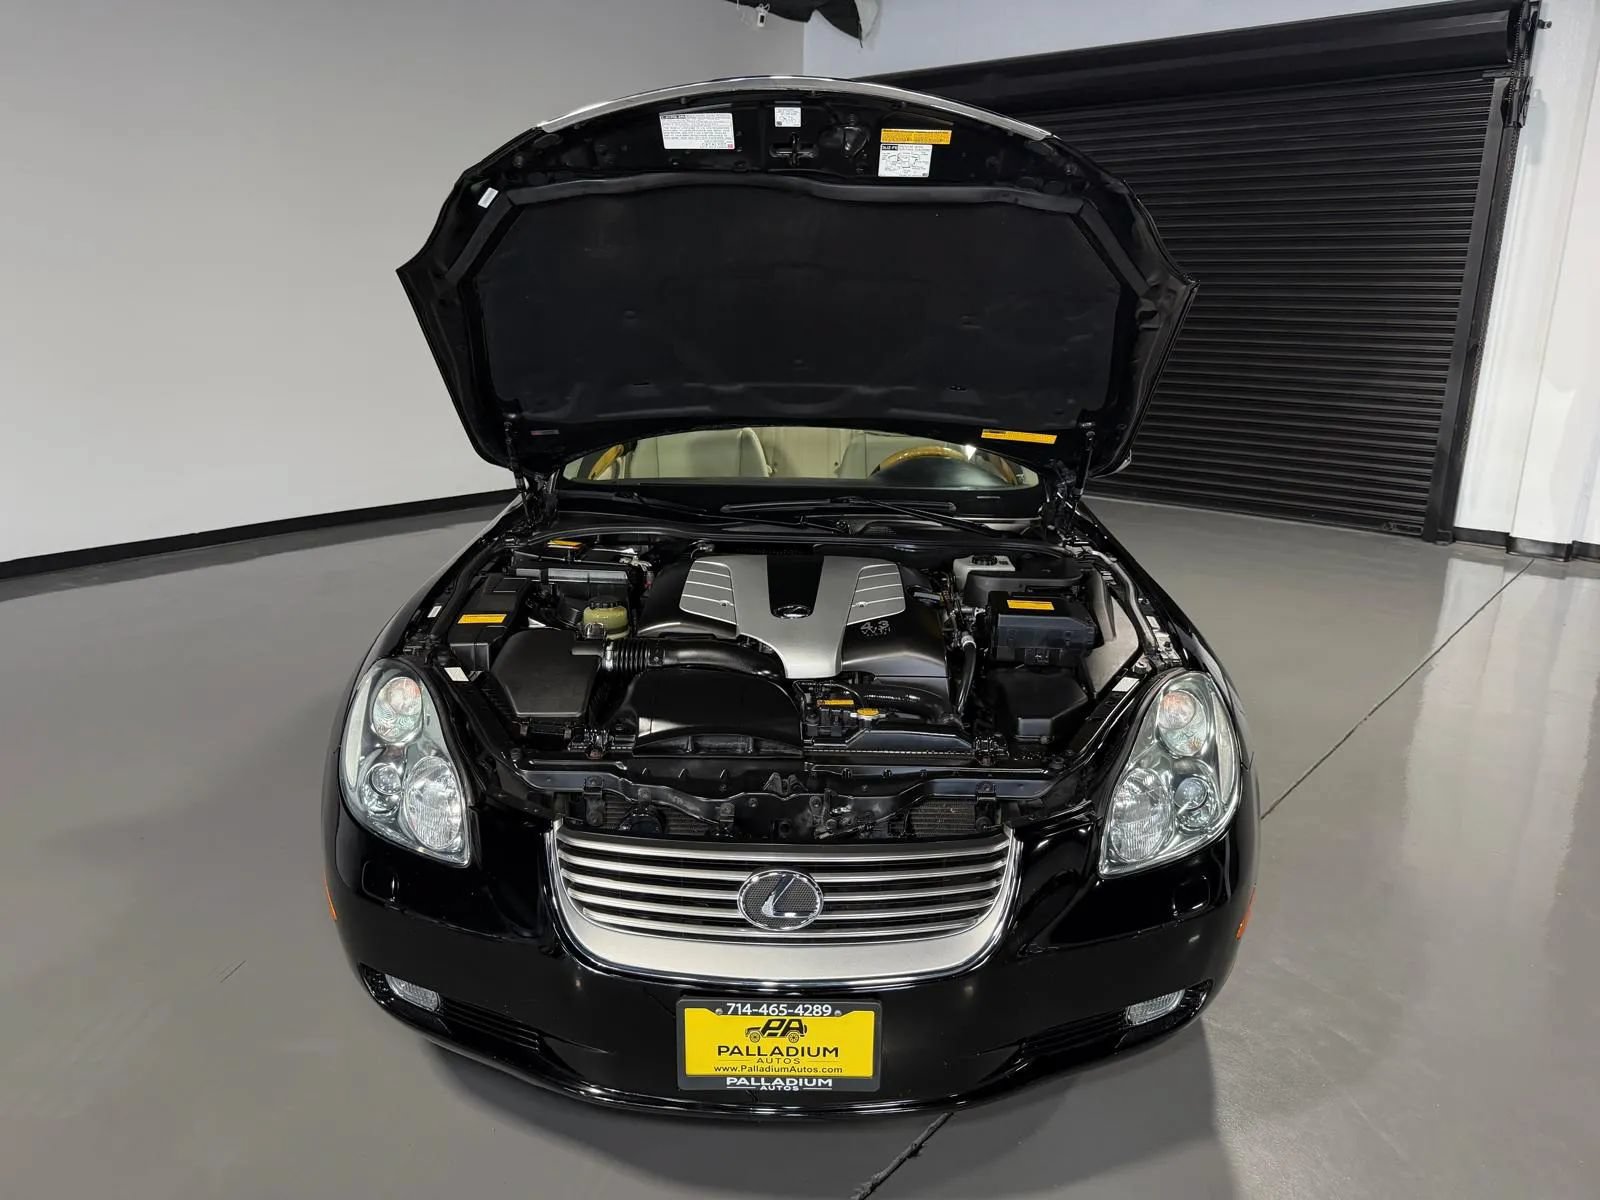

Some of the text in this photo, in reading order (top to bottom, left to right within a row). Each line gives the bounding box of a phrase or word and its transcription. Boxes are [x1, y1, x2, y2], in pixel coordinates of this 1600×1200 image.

[726, 1003, 832, 1017] 714-465-4289
[717, 1045, 839, 1058] PALLADIUM
[756, 1057, 801, 1065] AUTOS
[713, 1065, 843, 1074] www.PalladiumAutos.com
[726, 1077, 833, 1087] PALLADIUM
